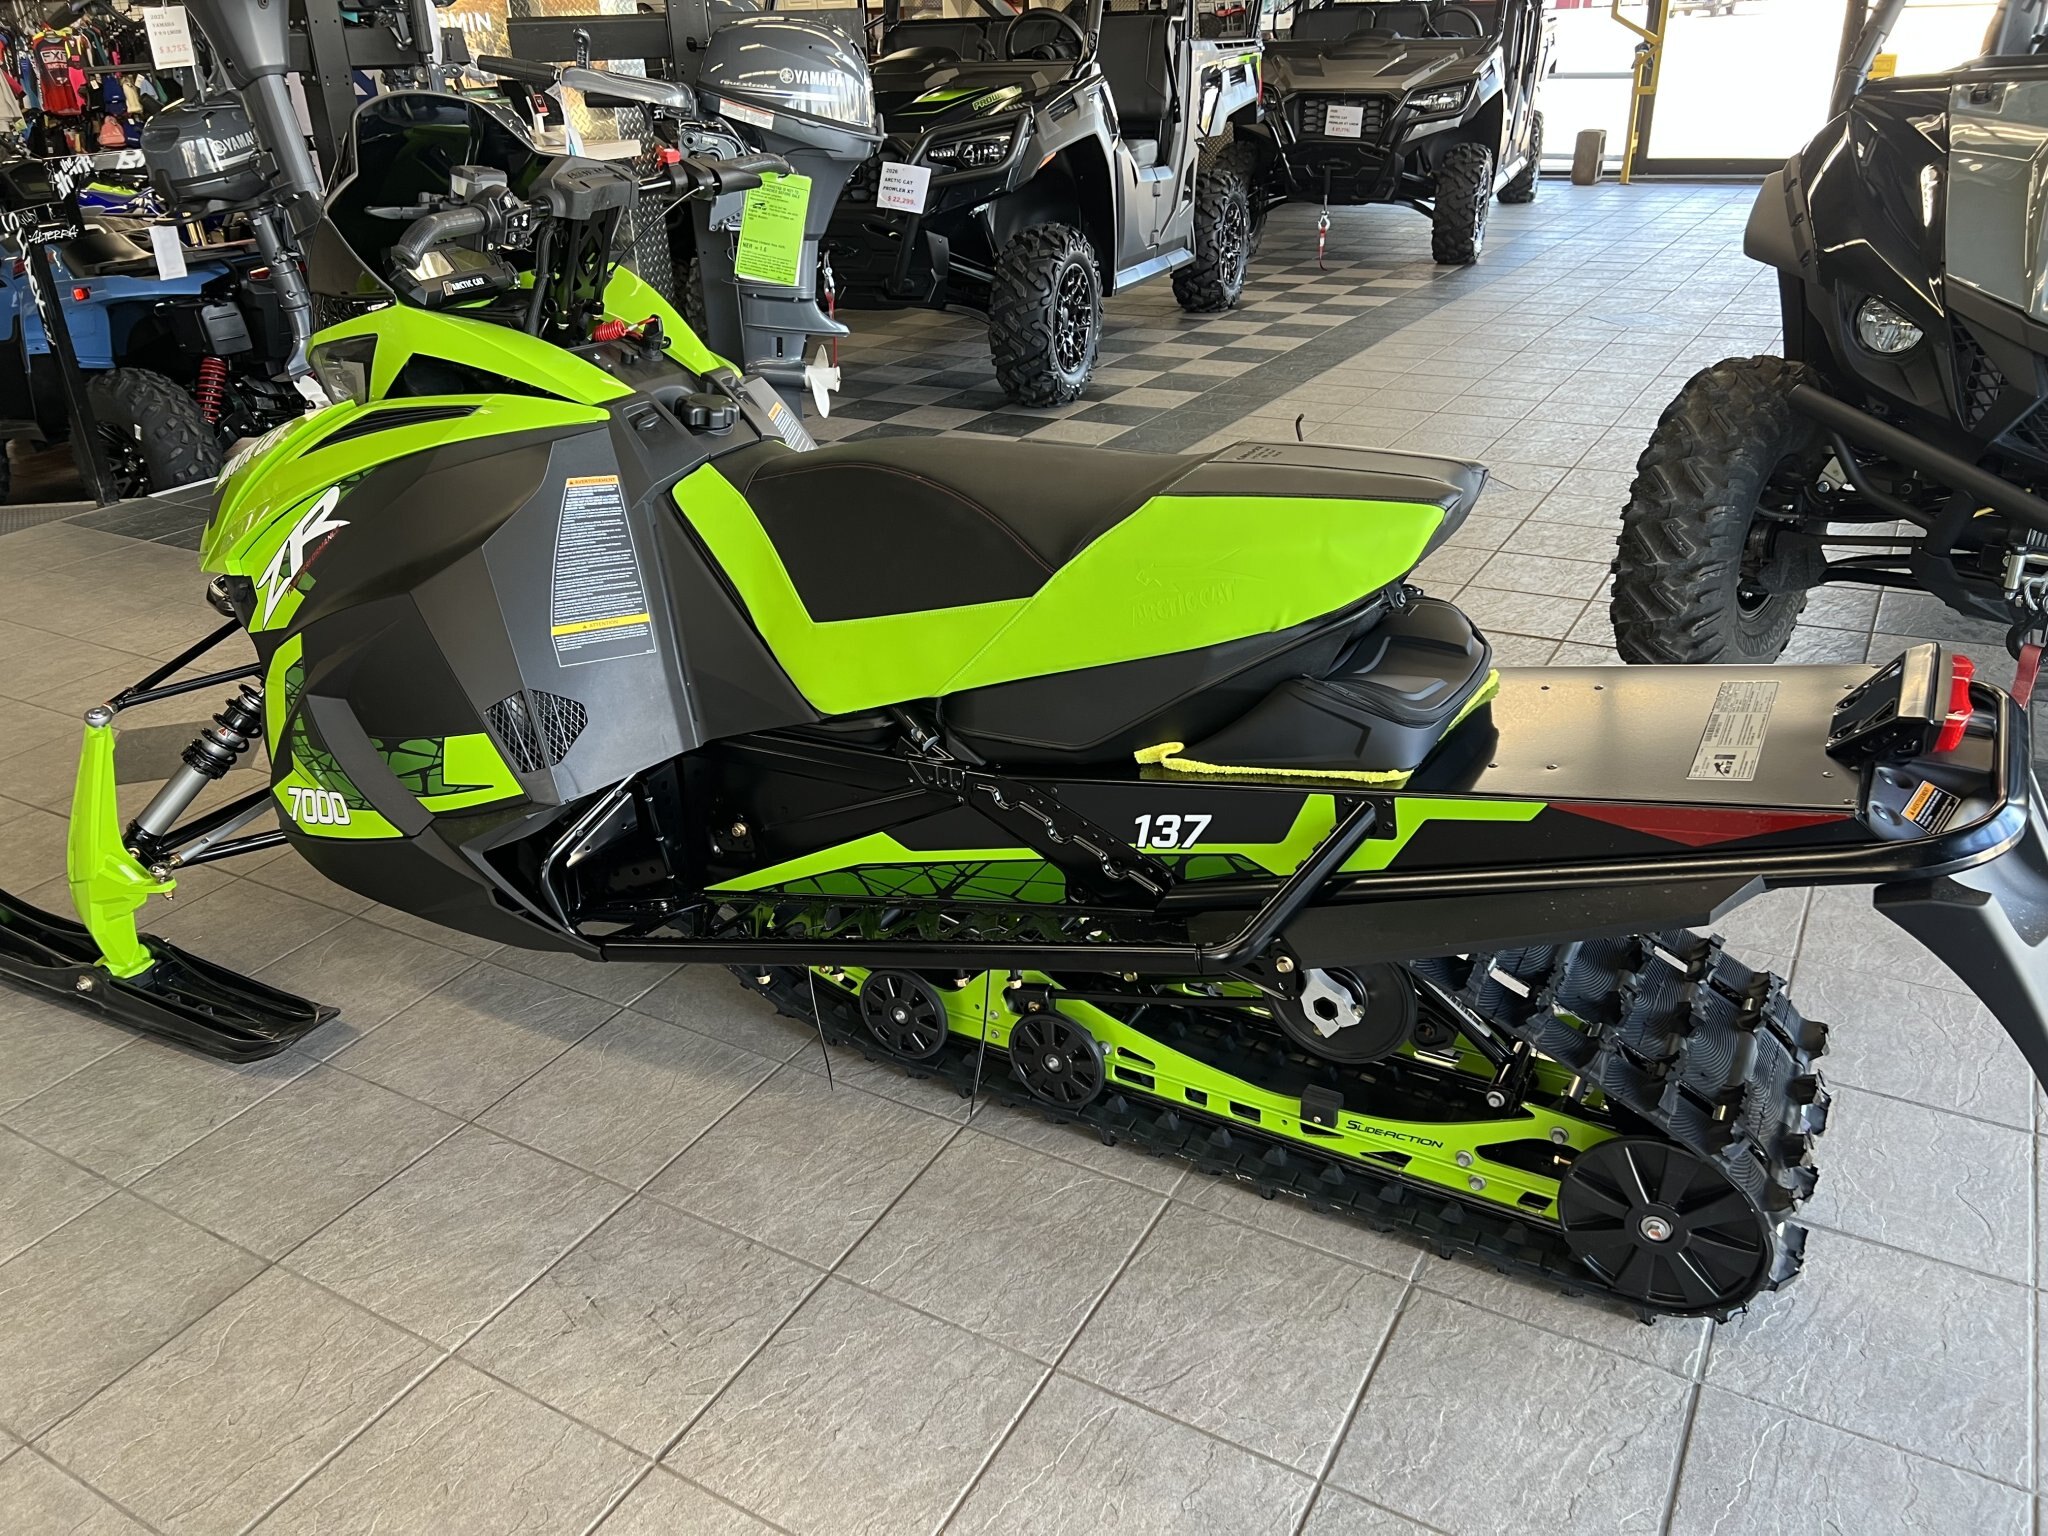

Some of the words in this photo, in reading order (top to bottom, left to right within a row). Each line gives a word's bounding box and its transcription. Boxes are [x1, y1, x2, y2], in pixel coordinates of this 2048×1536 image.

[794, 69, 845, 87] YAMAHA
[223, 131, 256, 152] YAMA
[450, 279, 473, 292] ARCTIC
[473, 277, 485, 287] CAT
[589, 619, 619, 628] ATTENTION
[287, 786, 352, 826] 7000
[1134, 814, 1213, 849] 137
